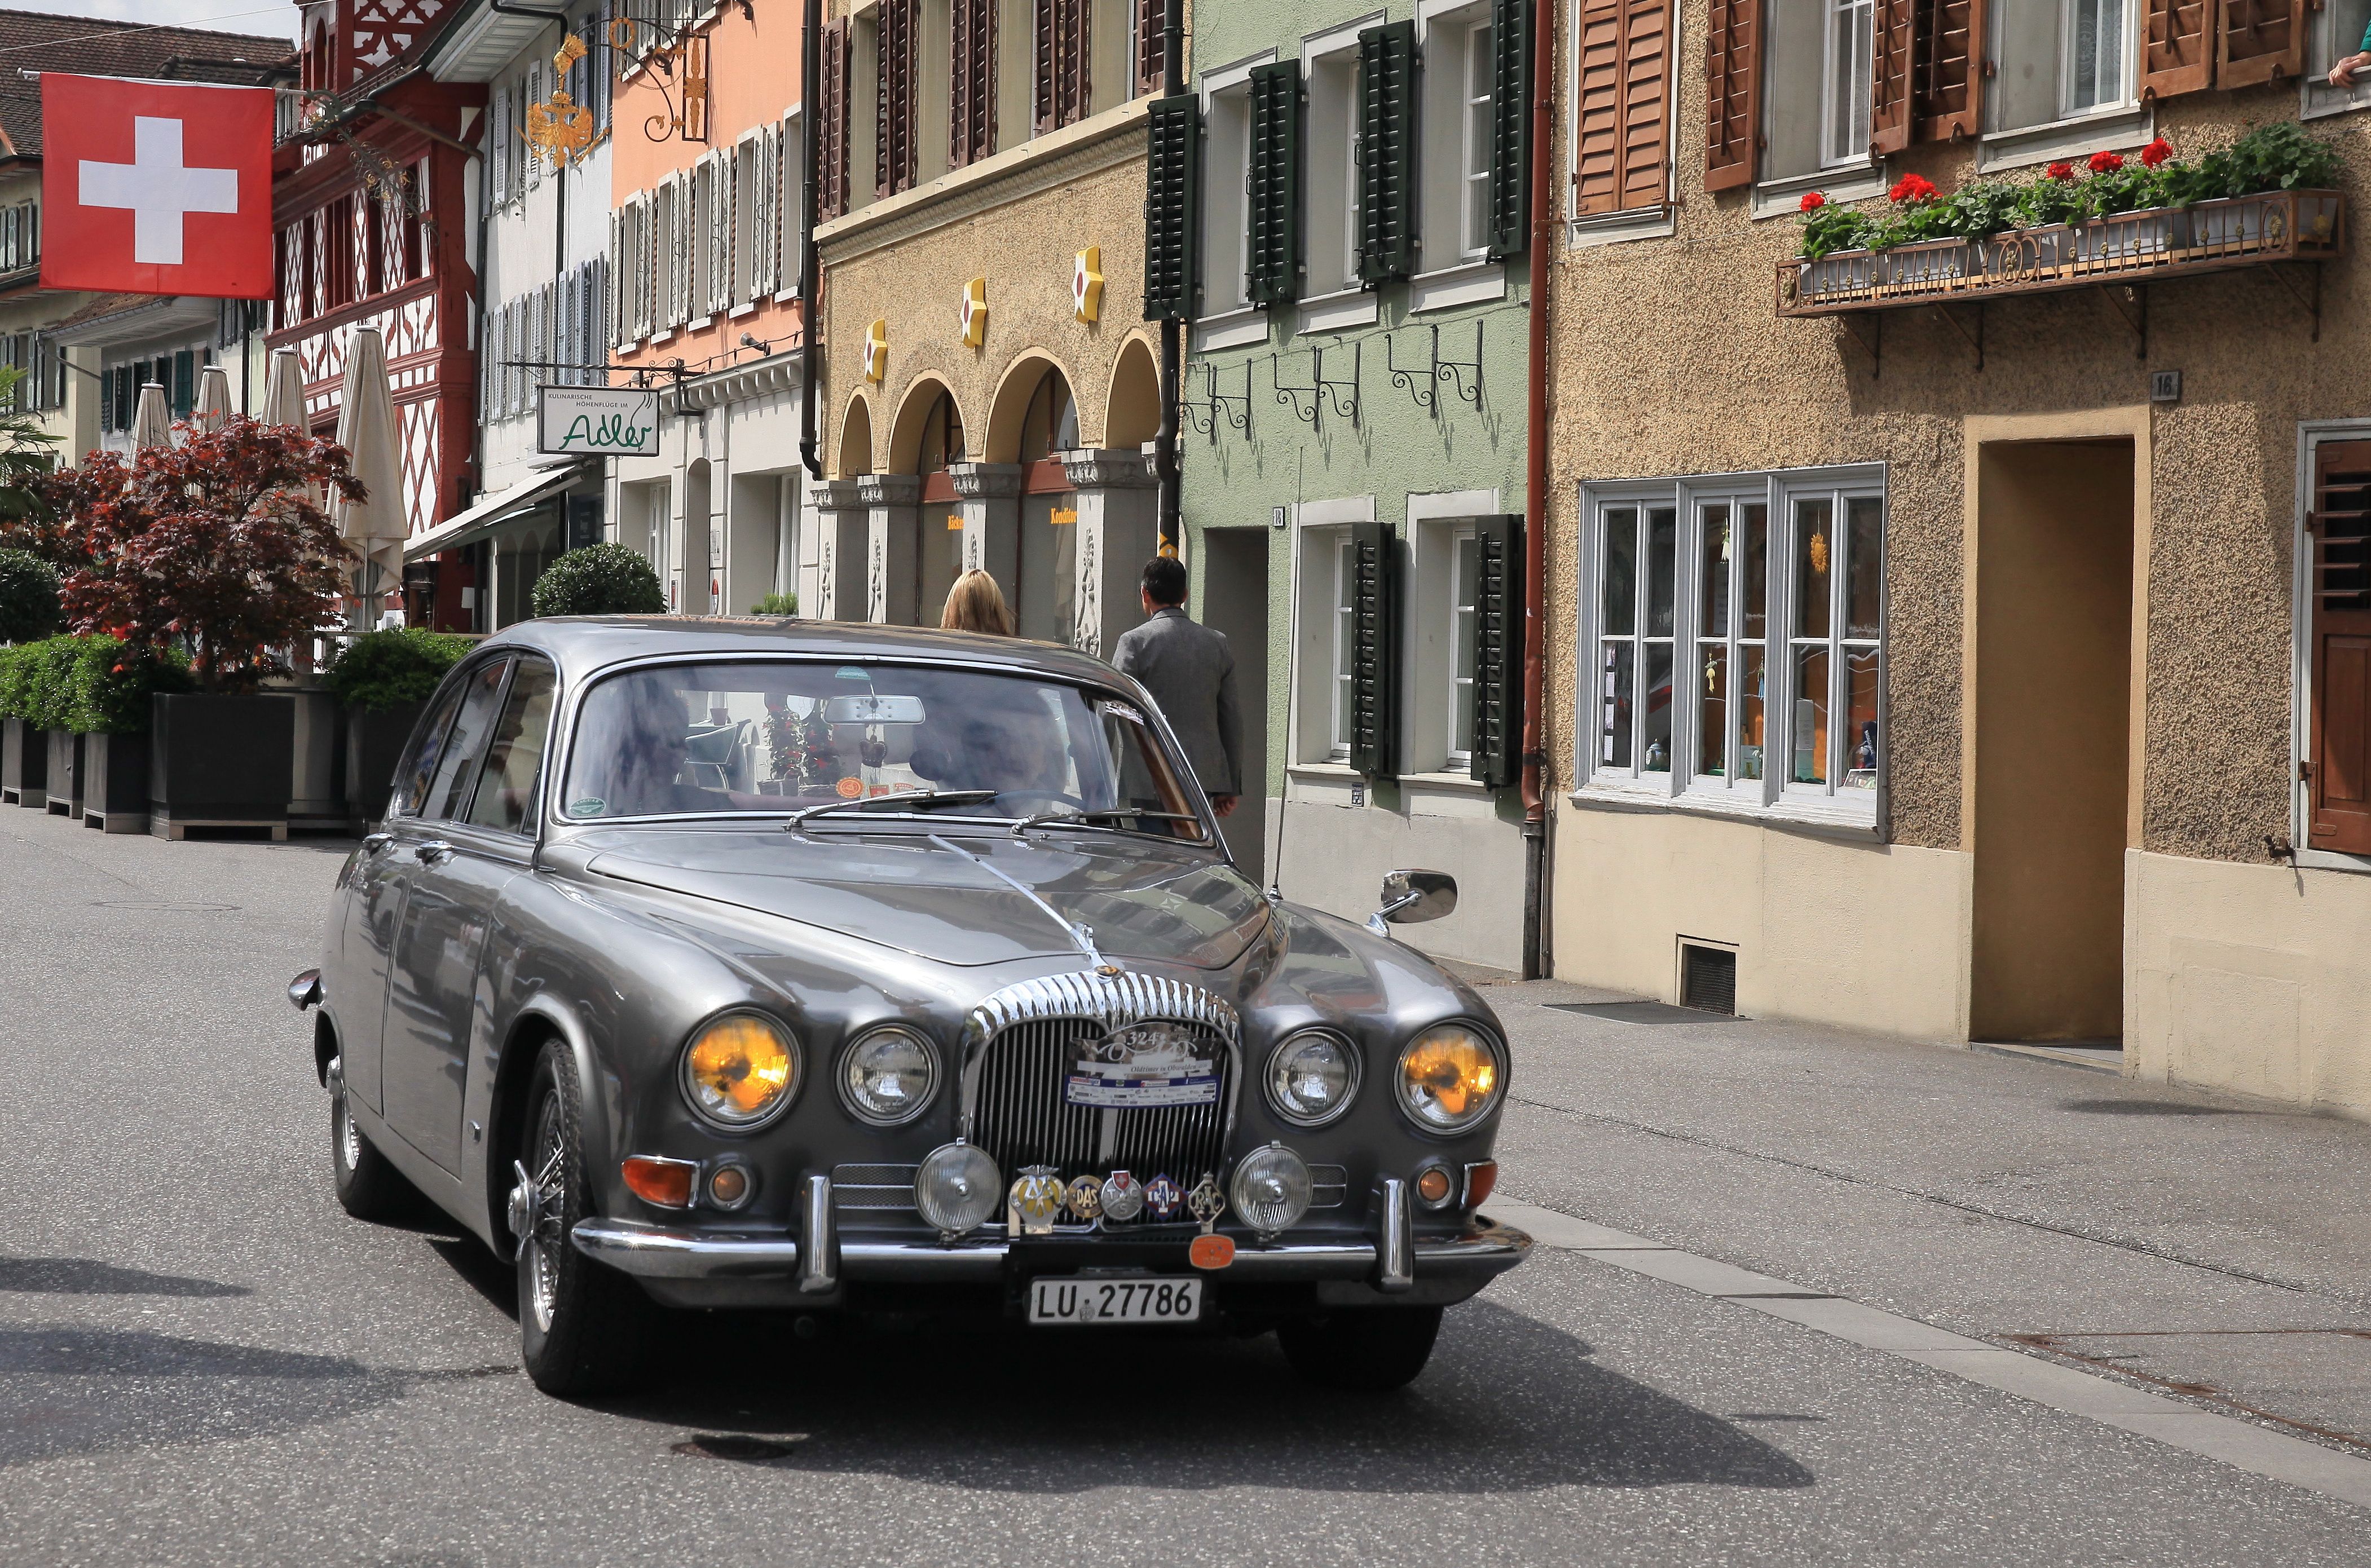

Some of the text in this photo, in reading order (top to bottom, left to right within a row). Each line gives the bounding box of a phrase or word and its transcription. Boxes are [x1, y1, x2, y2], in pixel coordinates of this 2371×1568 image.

[2157, 374, 2172, 396] 16
[558, 413, 653, 450] Adler
[1127, 1031, 1156, 1045] 324
[1077, 1186, 1098, 1208] DAS
[1195, 1186, 1220, 1214] RAC
[1038, 1282, 1192, 1318] LU 27786
